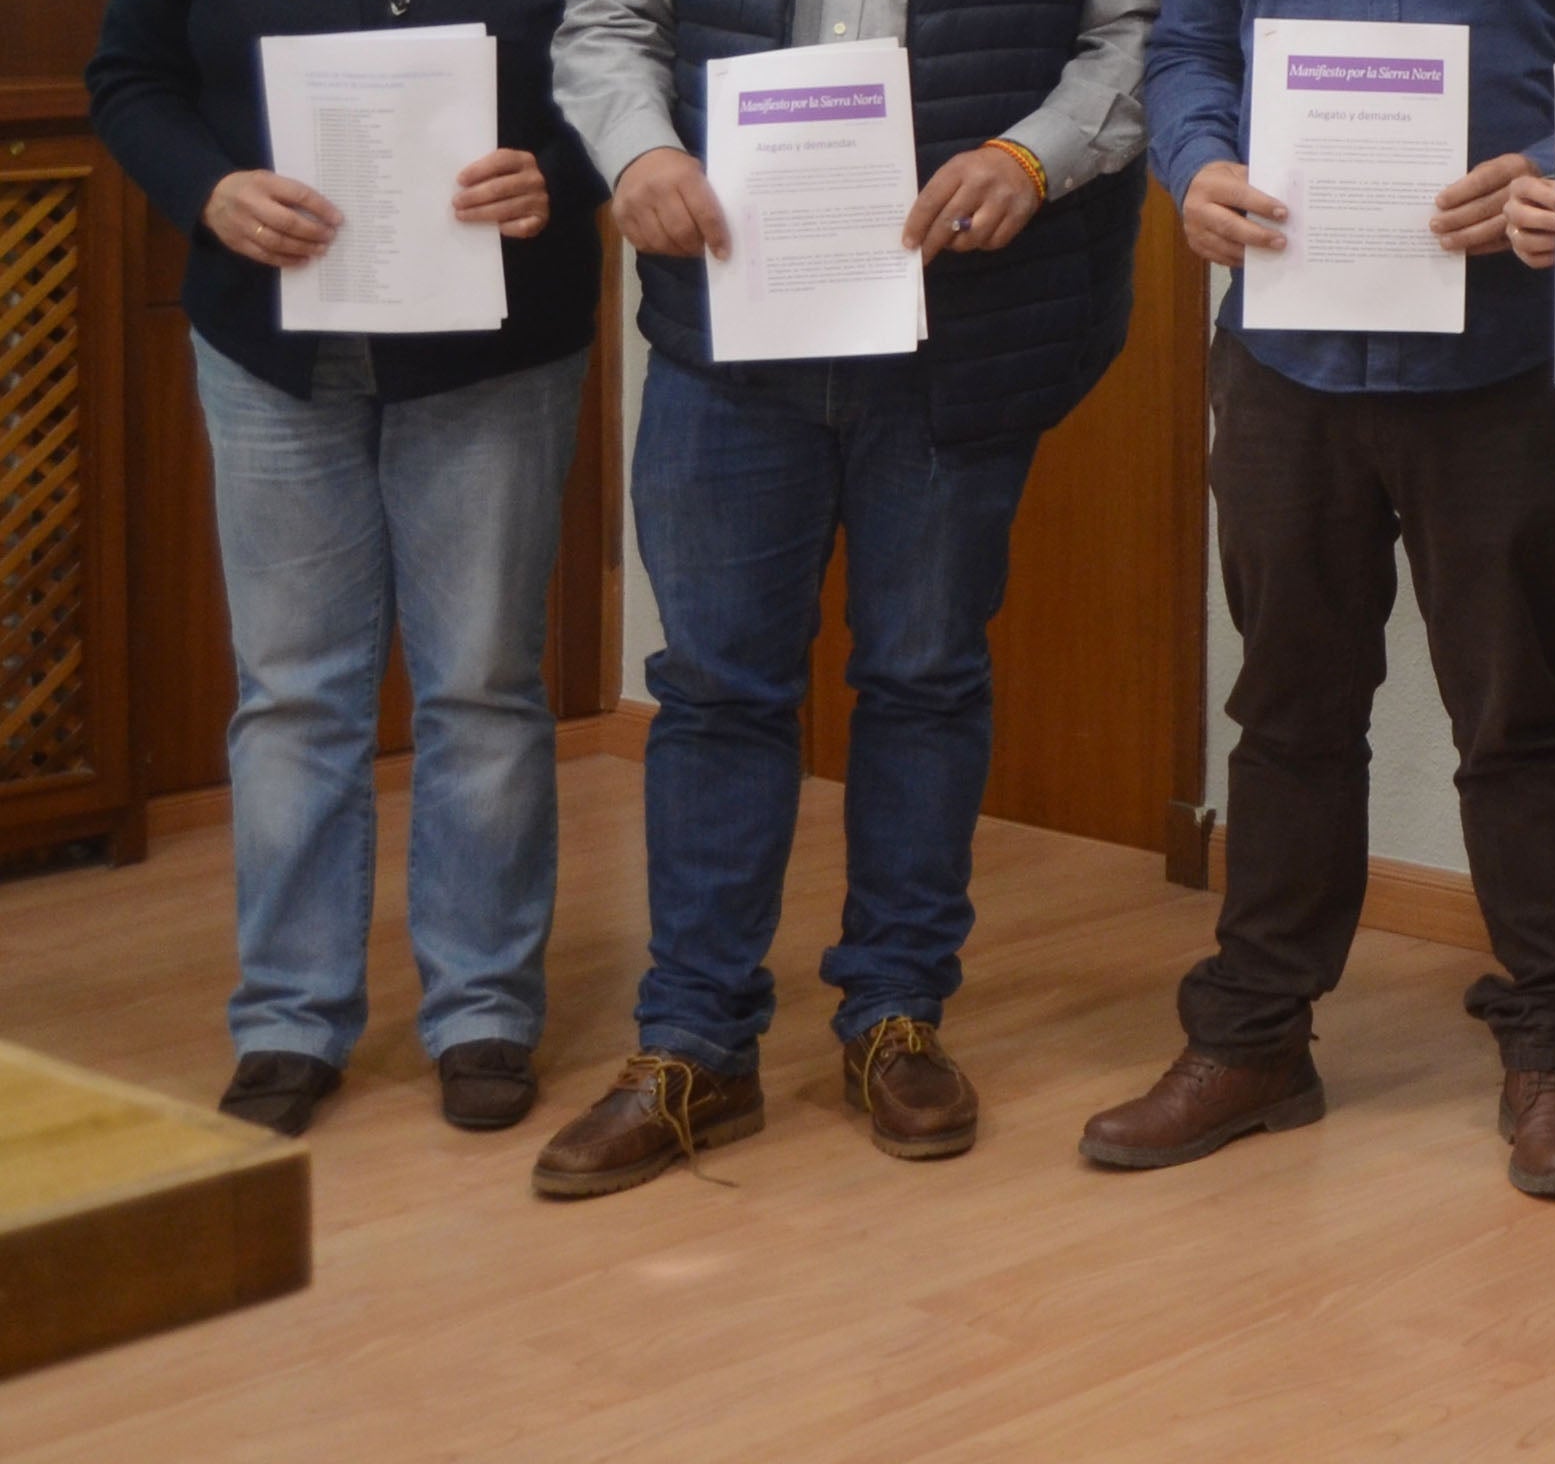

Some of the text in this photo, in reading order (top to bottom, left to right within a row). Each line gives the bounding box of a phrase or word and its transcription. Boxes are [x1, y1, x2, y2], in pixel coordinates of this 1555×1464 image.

[1289, 63, 1442, 81] Manifiesto por la Sierra Norte
[740, 93, 884, 114] Manifiesto por la Sierra Norte
